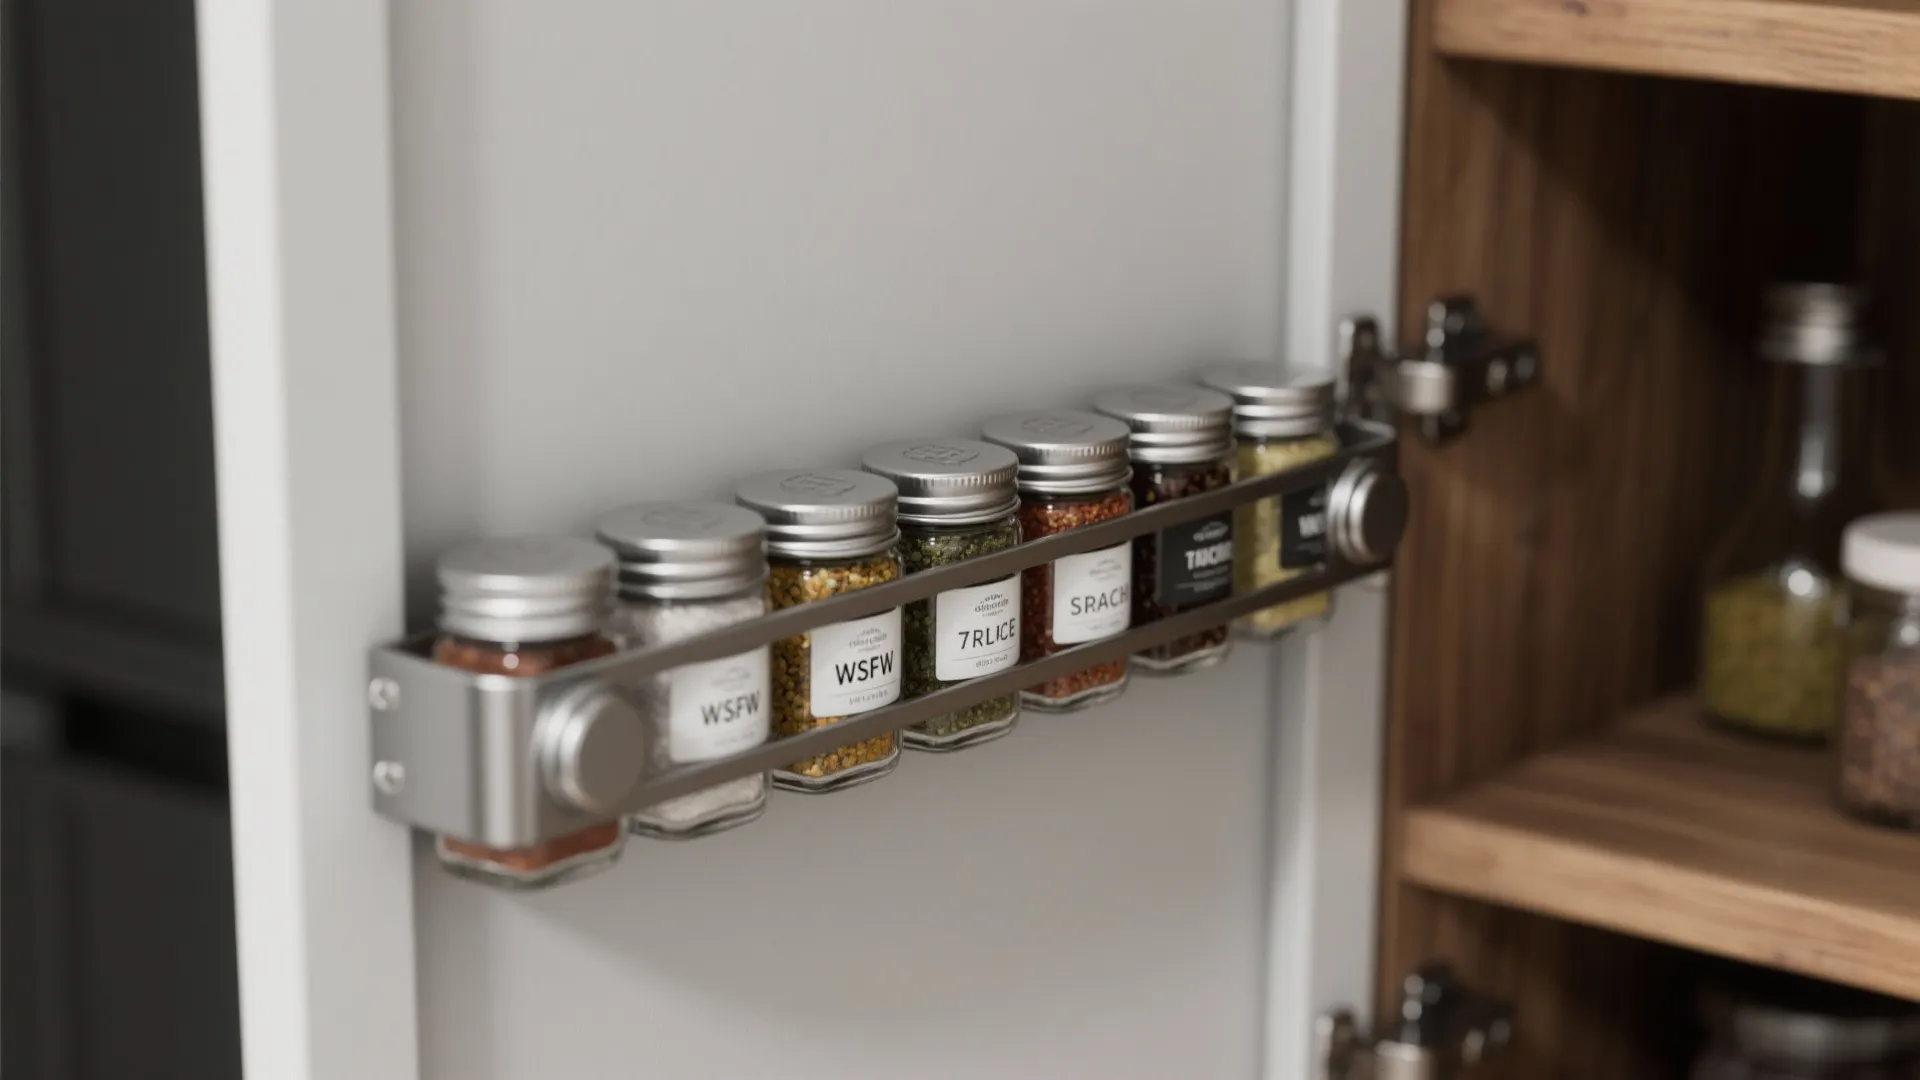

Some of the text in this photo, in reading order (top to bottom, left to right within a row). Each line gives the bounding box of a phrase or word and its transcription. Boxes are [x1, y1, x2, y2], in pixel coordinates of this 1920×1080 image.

[958, 617, 1016, 650] 7RLICE
[835, 651, 894, 686] WSFW
[701, 690, 760, 726] WSFW
